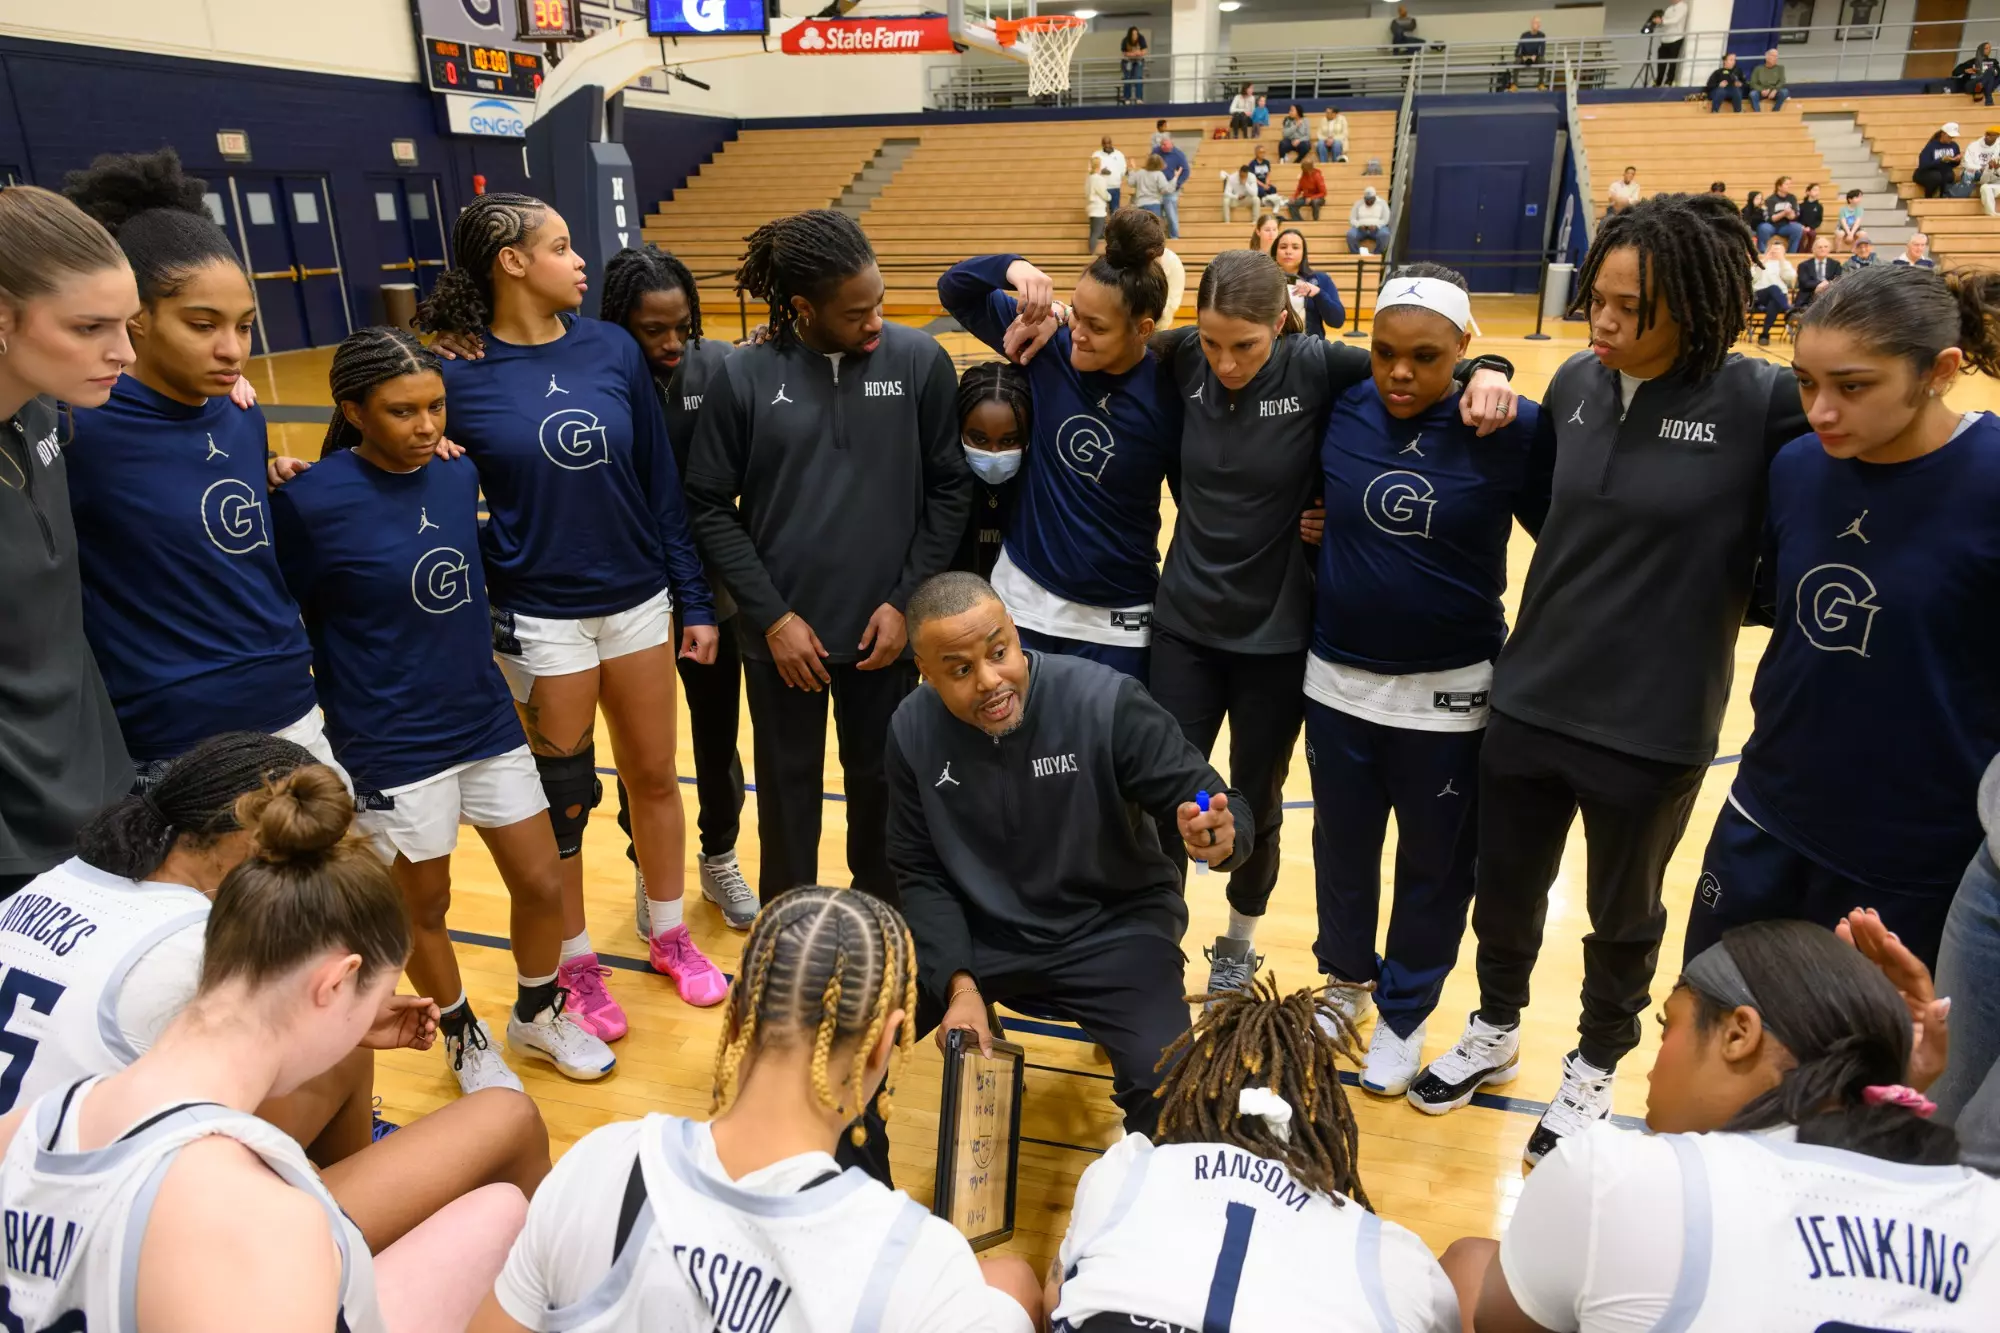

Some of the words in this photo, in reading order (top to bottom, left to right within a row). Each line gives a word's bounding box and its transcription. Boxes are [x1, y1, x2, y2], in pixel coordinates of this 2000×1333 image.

[534, 0, 564, 28] 30
[445, 61, 458, 85] 0
[473, 48, 508, 74] 10:00
[611, 177, 630, 249] HOY
[683, 395, 703, 411] HOY
[864, 381, 903, 397] HOYAS
[1259, 396, 1301, 417] HOYAS
[1658, 418, 1717, 443] HOYAS
[1031, 753, 1078, 778] HOYAS
[0, 893, 98, 957] MYRICKS
[0, 961, 67, 1115] 5
[1194, 1150, 1311, 1212] RANSOM
[4, 1209, 83, 1288] RYAN
[1202, 1200, 1257, 1333] 1
[1796, 1215, 1969, 1304] JENKINS
[673, 1244, 792, 1333] SSION
